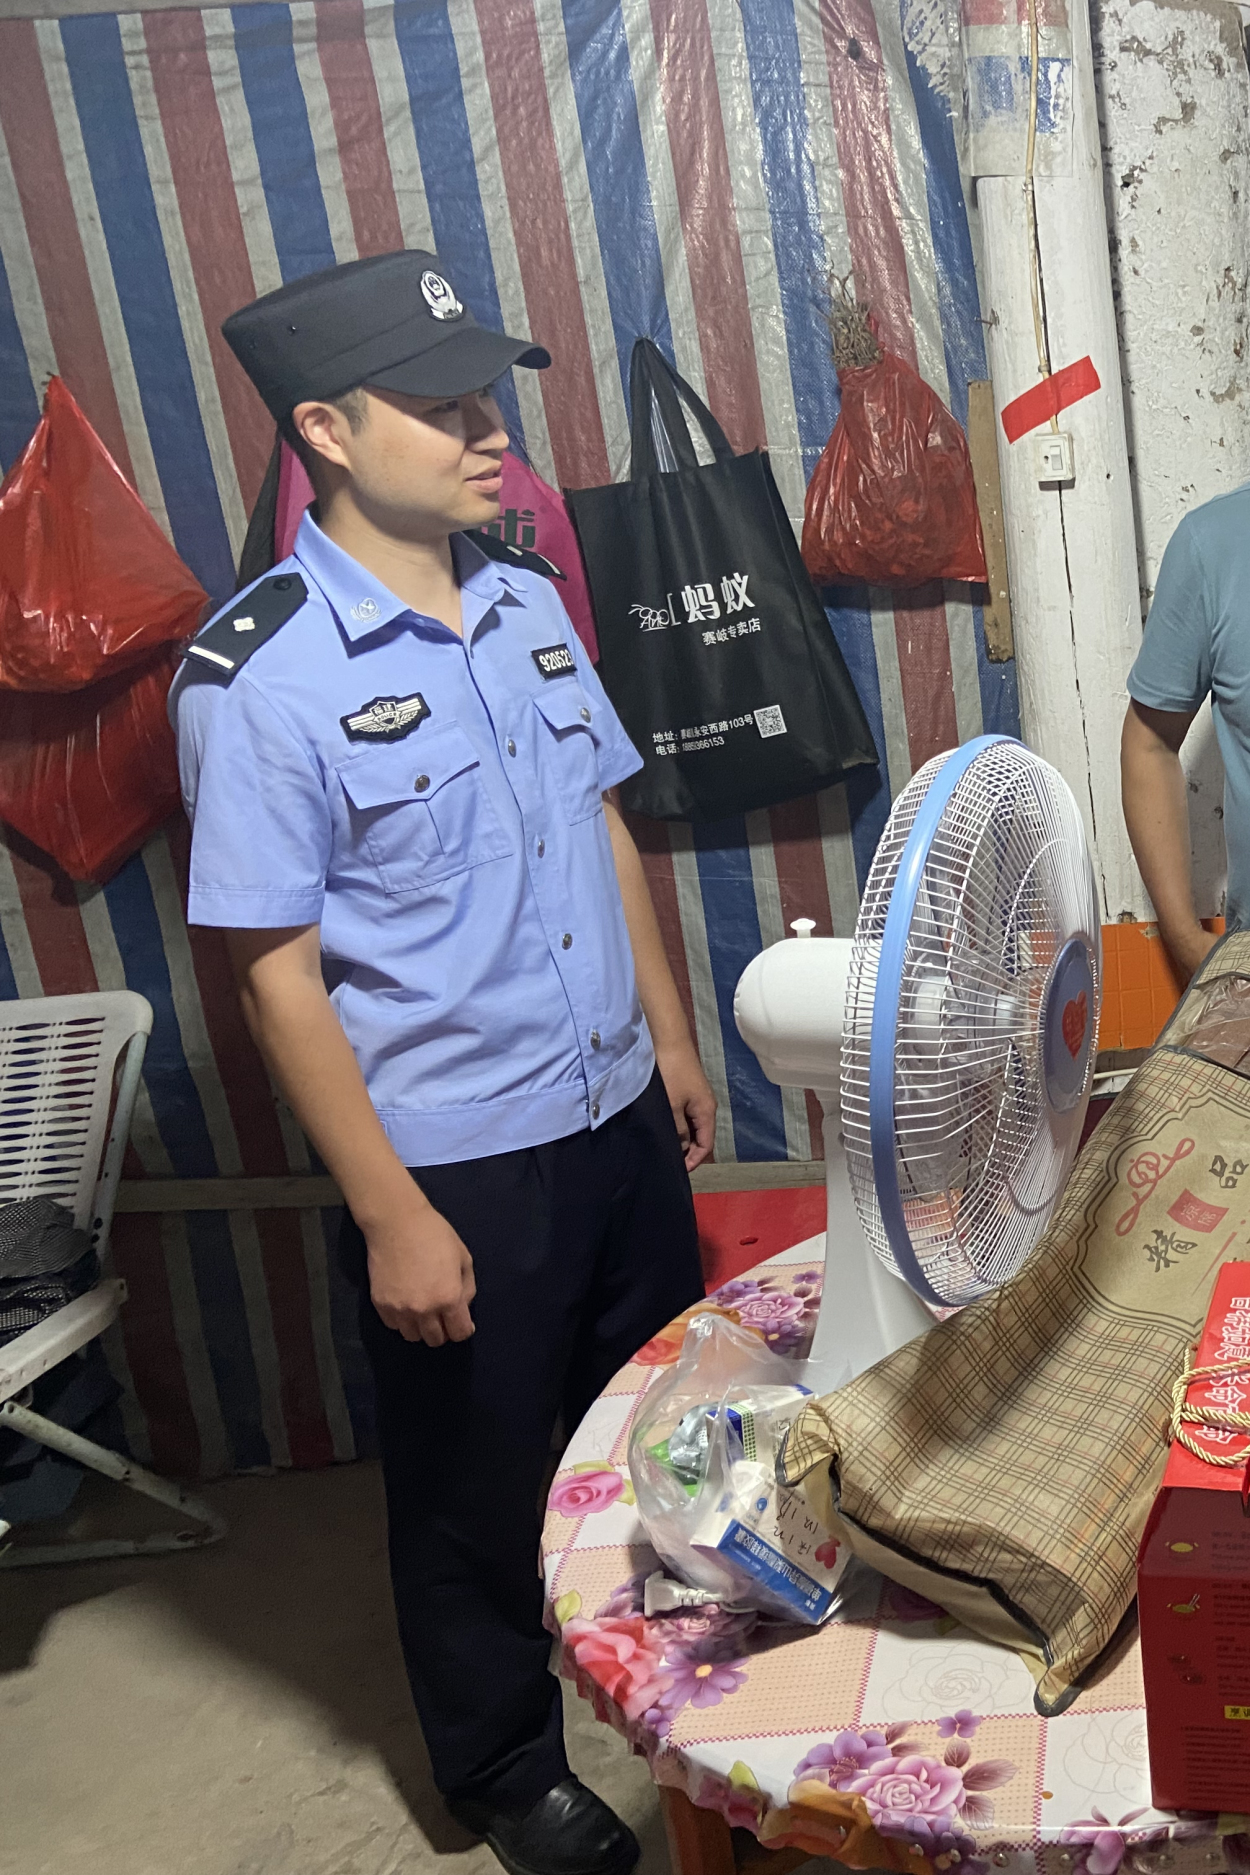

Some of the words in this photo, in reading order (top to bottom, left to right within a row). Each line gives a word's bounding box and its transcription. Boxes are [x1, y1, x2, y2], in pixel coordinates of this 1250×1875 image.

[681, 572, 755, 623] 蚂蚁
[702, 617, 761, 645] 赛岐专卖店
